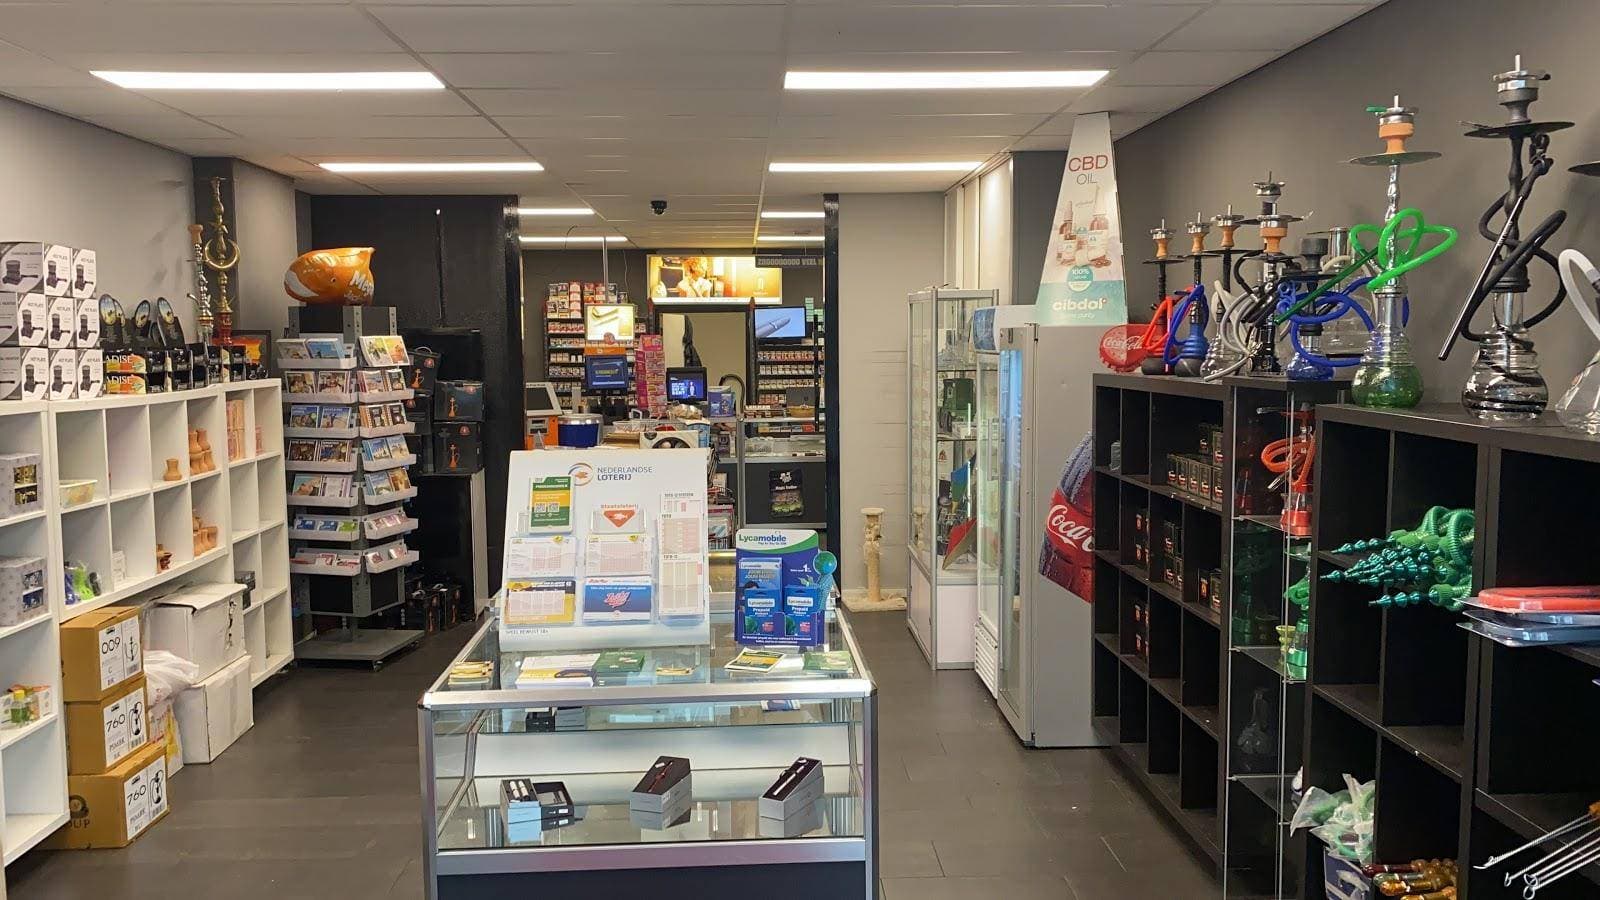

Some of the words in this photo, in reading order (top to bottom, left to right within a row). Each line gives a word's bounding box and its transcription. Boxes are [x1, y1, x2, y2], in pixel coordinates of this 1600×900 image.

[1068, 154, 1108, 172] CBD
[1076, 173, 1098, 186] OIL
[1071, 267, 1089, 275] 100%
[1052, 298, 1103, 311] cibdol
[597, 466, 653, 474] NEDERLANDSE
[738, 534, 787, 543] Lycamobile
[101, 636, 121, 655] 009
[106, 713, 126, 733] 760
[127, 784, 147, 806] 760
